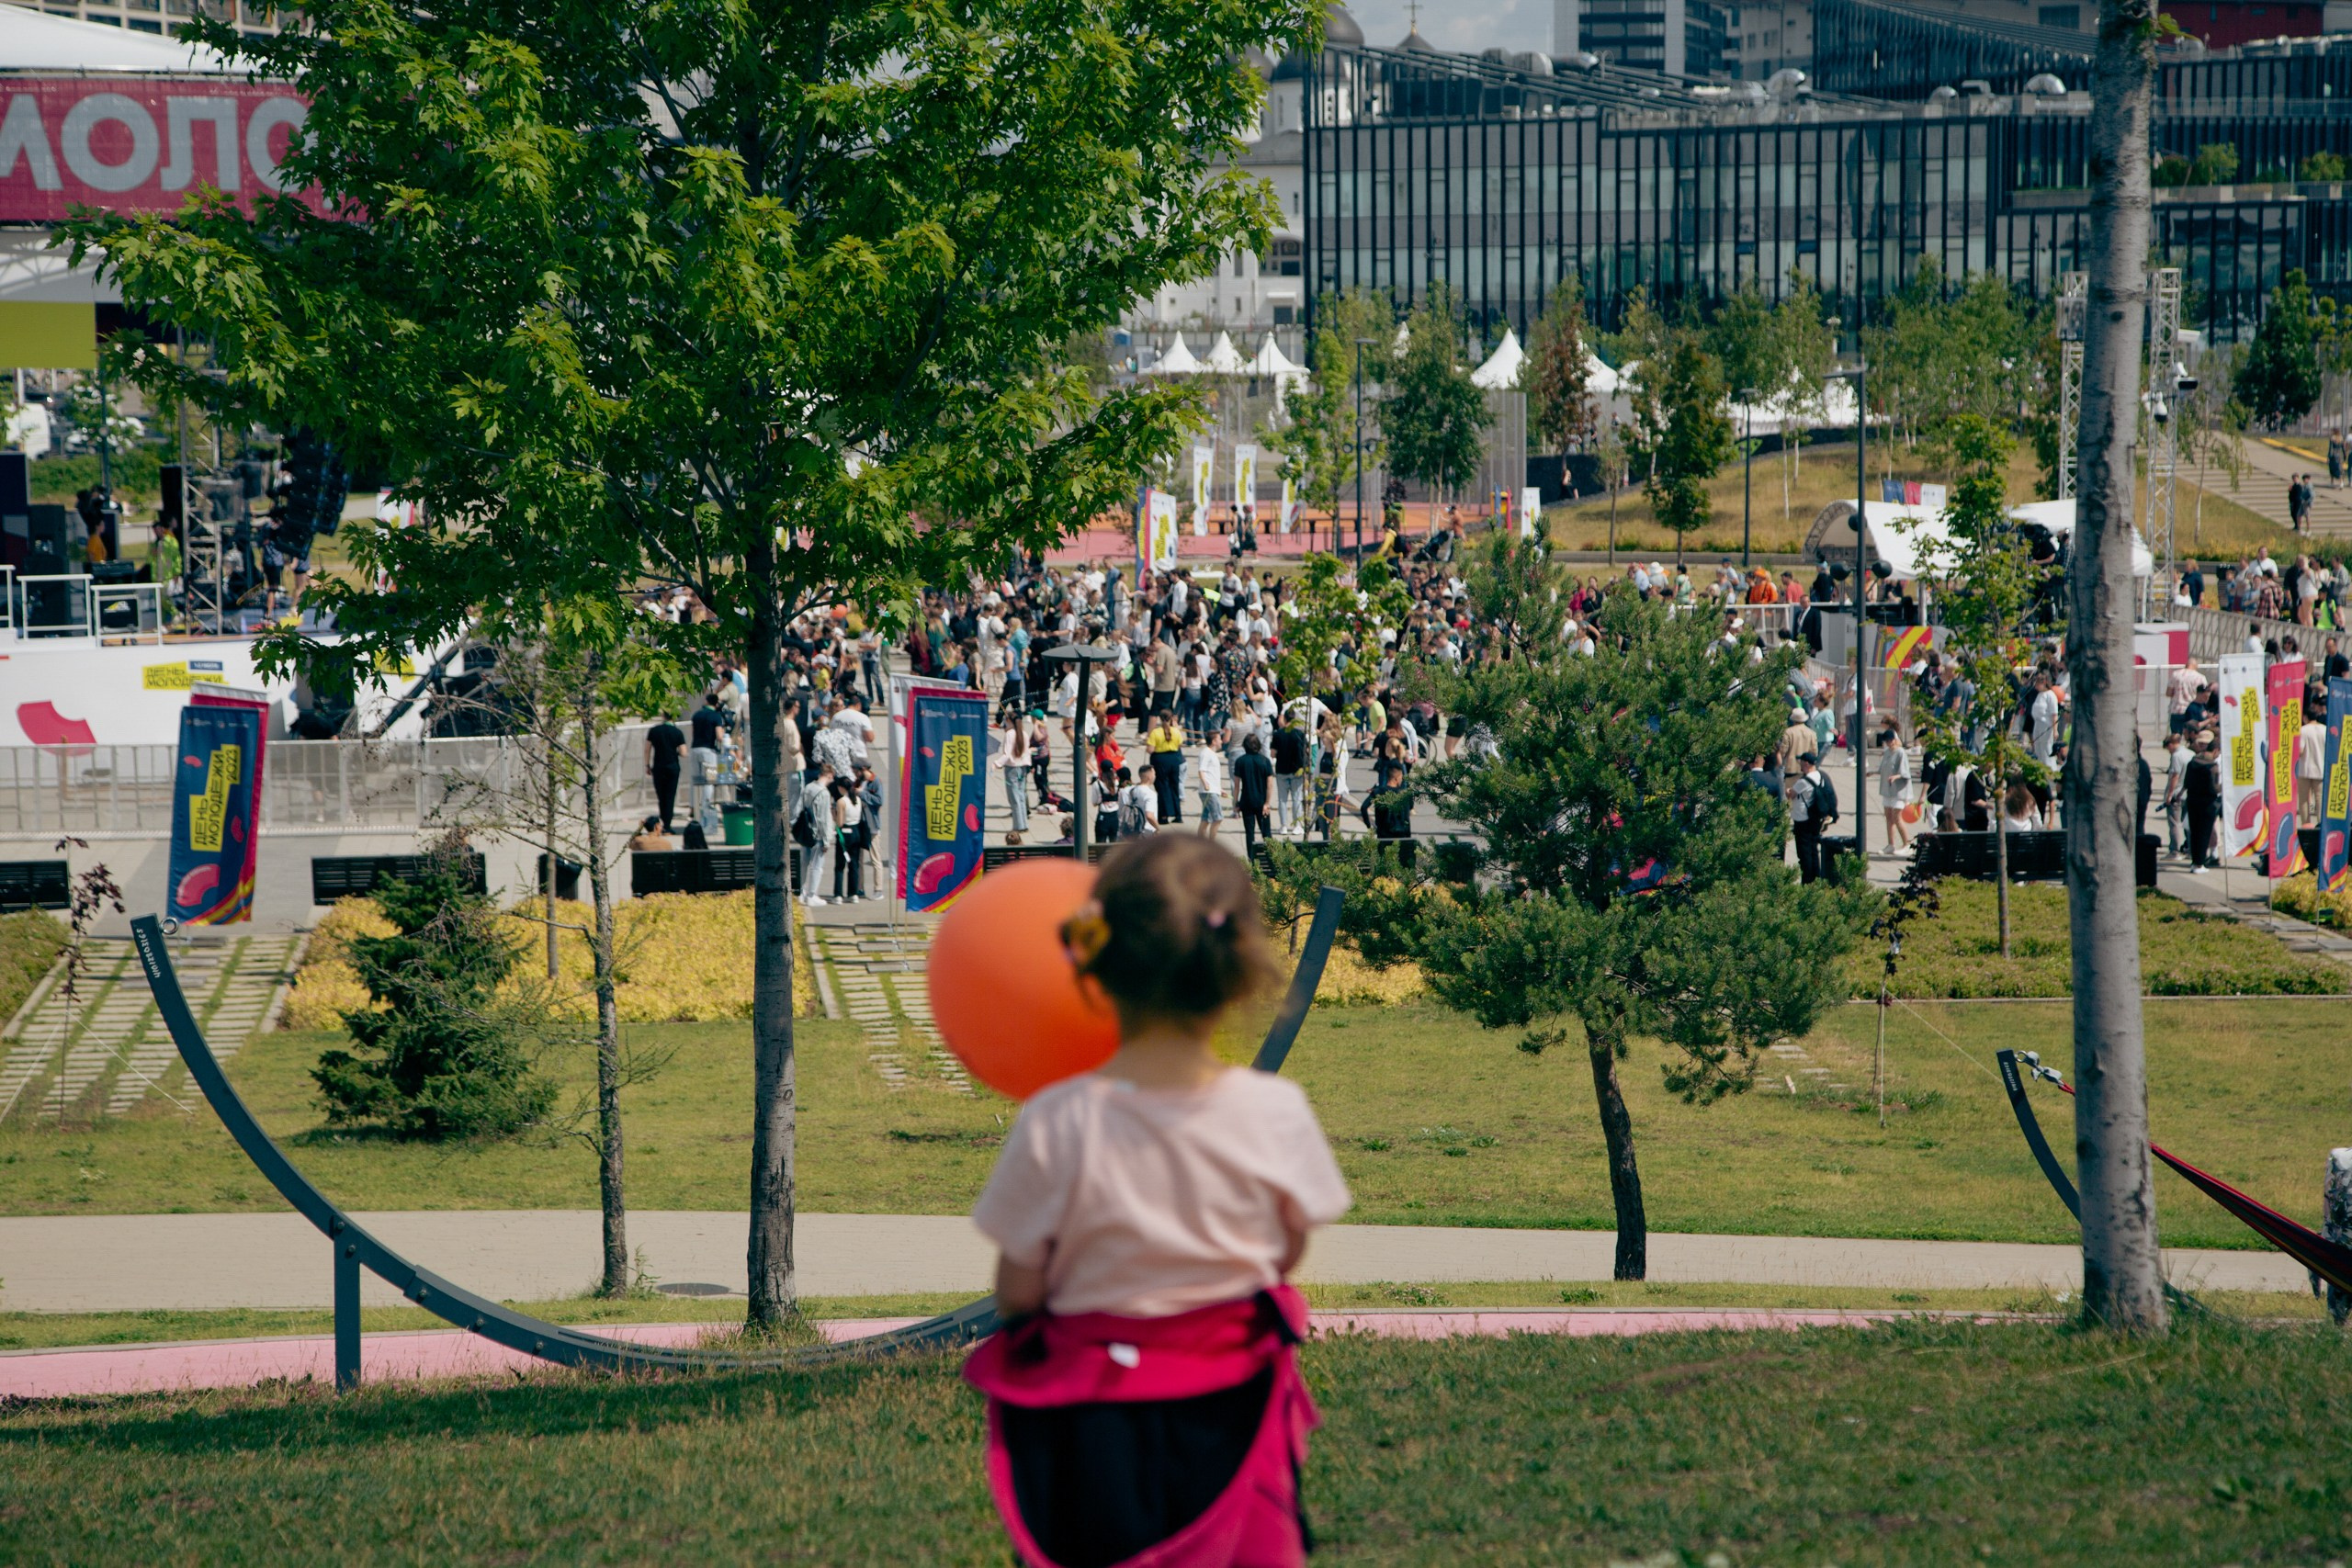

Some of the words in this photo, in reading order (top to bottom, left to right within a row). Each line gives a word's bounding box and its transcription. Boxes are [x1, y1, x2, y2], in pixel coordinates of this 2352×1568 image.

[0, 93, 319, 193] МОЛО
[2249, 690, 2259, 719] 2023
[2290, 702, 2300, 733] 2023
[226, 749, 238, 781] 2023
[957, 739, 969, 772] 2023
[2235, 738, 2245, 781] ДЕНЬ
[931, 788, 943, 835] ДЕНЬ
[943, 745, 956, 835] МОЛОДЁЖИ
[2329, 766, 2340, 813] ДЕНЬ
[195, 797, 208, 845] ДЕНЬ
